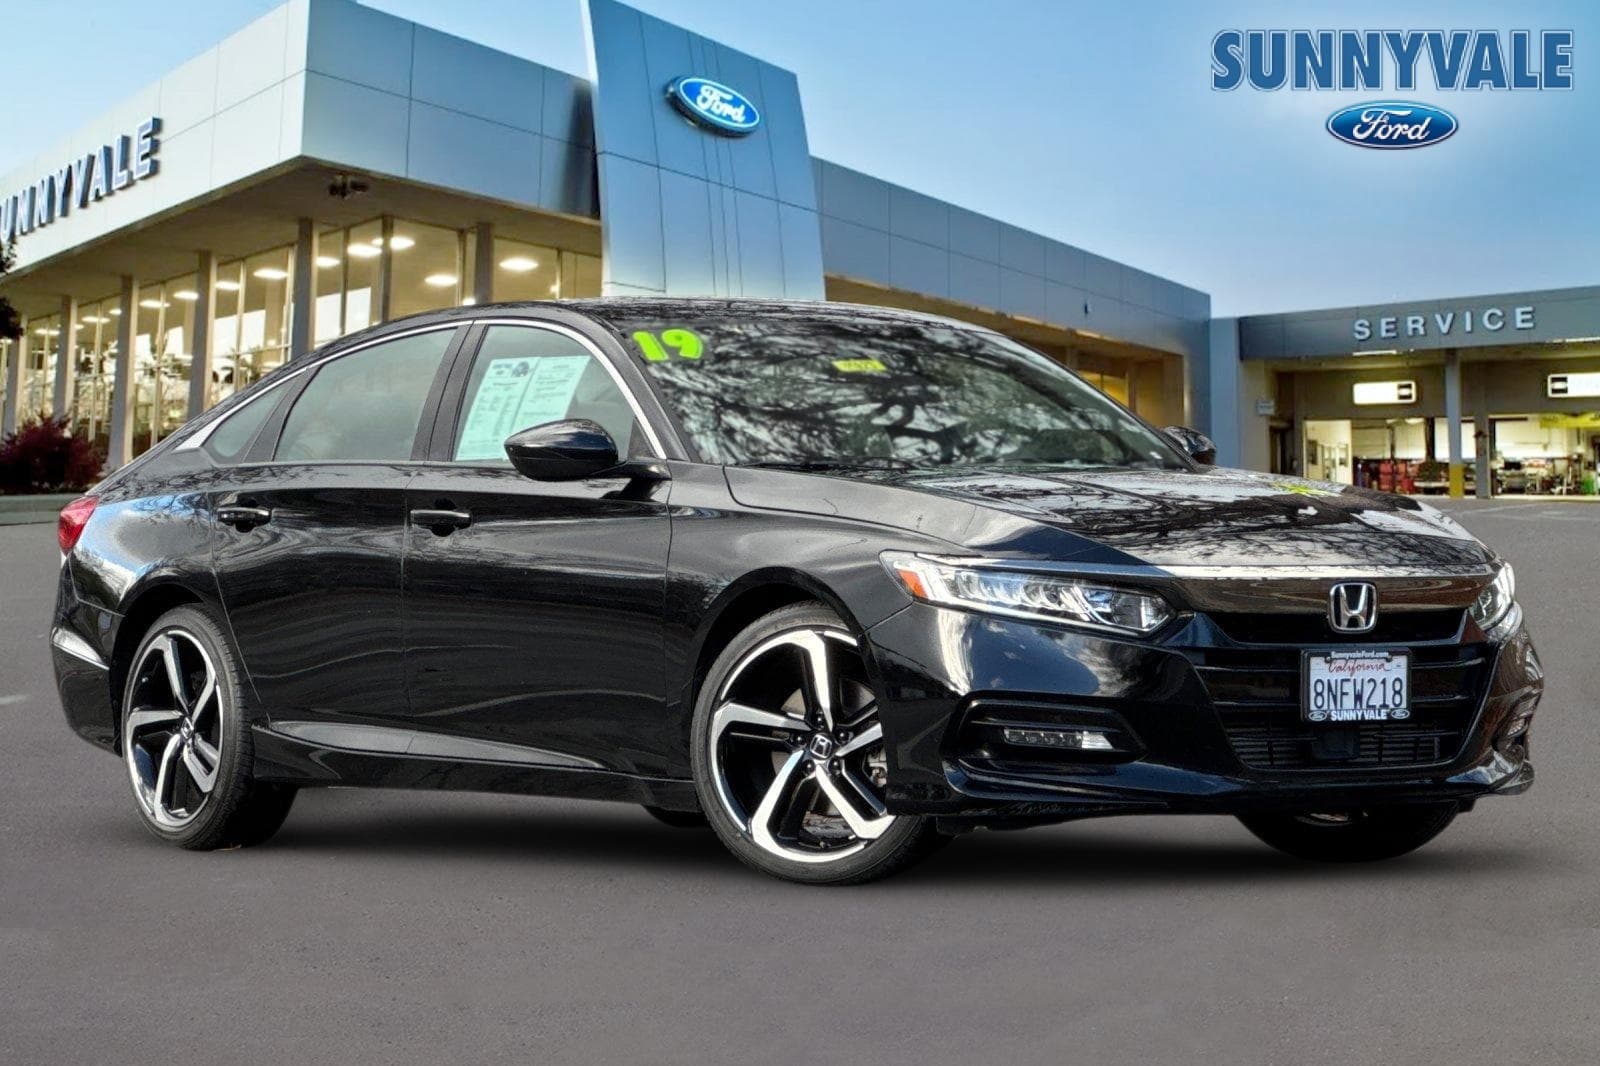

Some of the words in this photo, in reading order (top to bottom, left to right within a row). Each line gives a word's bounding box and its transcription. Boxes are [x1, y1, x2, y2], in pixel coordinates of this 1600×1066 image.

[696, 85, 746, 122] Ford
[0, 117, 162, 244] UNNYVALE
[1353, 306, 1537, 341] SERVICE
[632, 327, 703, 361] 19
[1328, 659, 1392, 677] California
[1313, 677, 1403, 710] 8NFW218
[1331, 710, 1388, 721] SUNNYVALE
